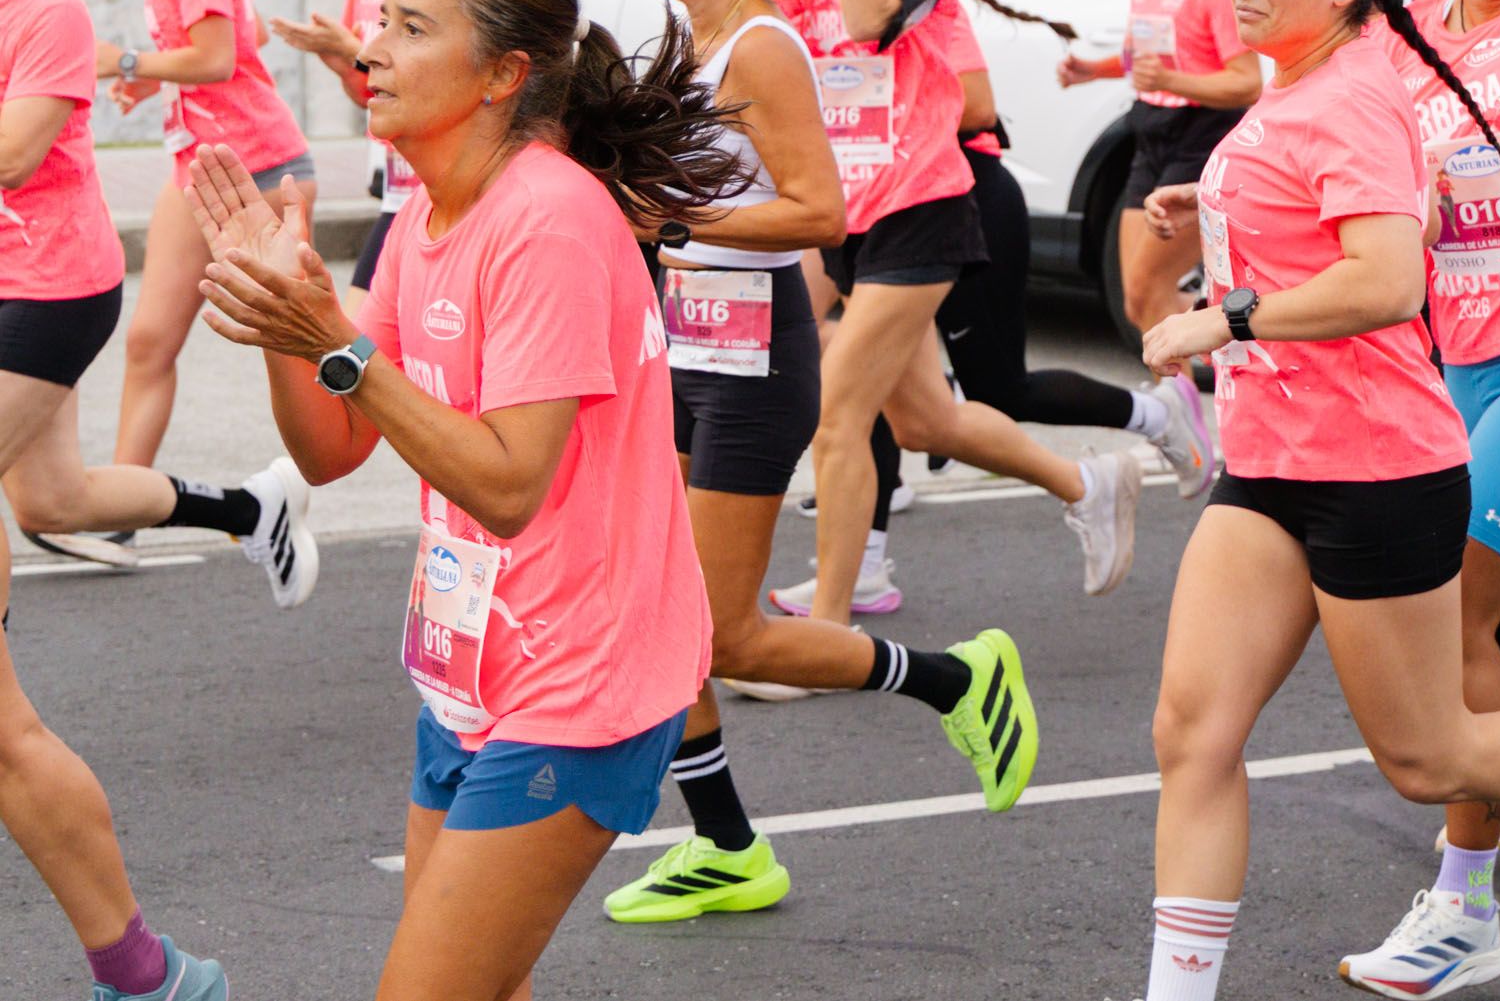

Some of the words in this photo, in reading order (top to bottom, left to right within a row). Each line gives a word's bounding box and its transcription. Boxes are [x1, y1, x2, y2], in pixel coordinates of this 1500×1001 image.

[822, 106, 860, 126] 016
[1477, 239, 1487, 249] LA
[1444, 256, 1486, 268] OYSHO
[683, 298, 730, 323] 016
[424, 619, 452, 660] 016
